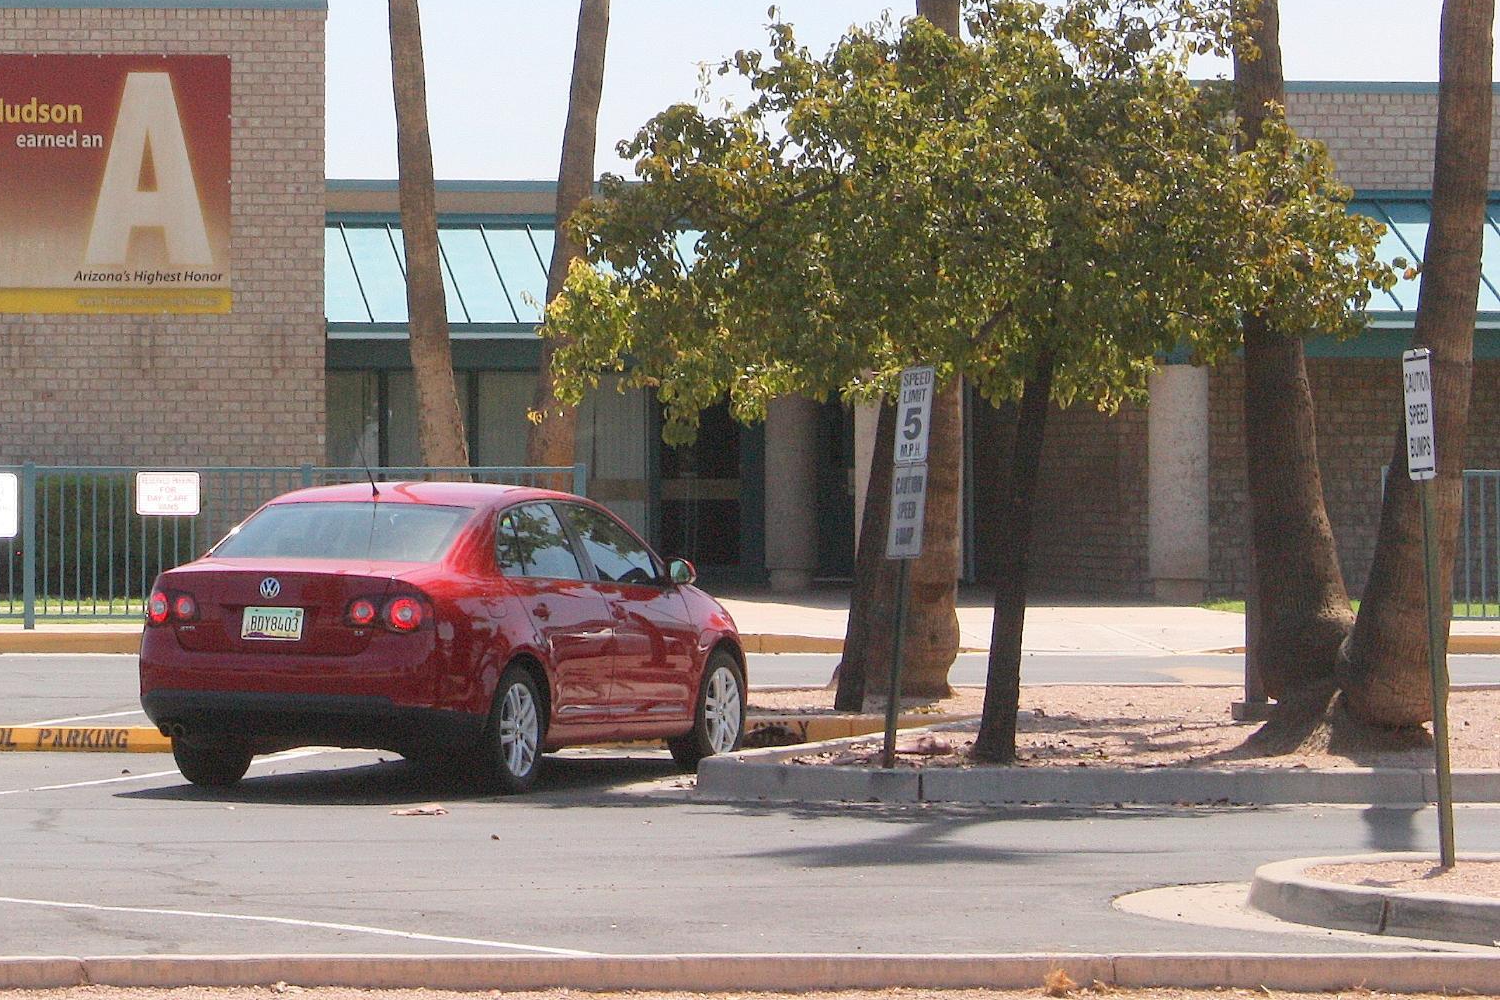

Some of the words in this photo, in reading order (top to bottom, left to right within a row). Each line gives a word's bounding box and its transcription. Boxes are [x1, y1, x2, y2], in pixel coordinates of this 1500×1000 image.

[16, 130, 78, 149] earned
[81, 133, 103, 149] an
[85, 71, 214, 265] A
[73, 270, 131, 282] Arizona's
[134, 271, 181, 285] Highest
[184, 271, 223, 283] Honor
[903, 372, 931, 387] SPEED
[903, 387, 927, 404] LIMIT
[902, 407, 922, 440] 5
[1409, 403, 1428, 426] SPEED
[895, 475, 924, 495] CAUTION
[250, 615, 299, 632] BDY8403
[36, 728, 129, 748] PARKING
